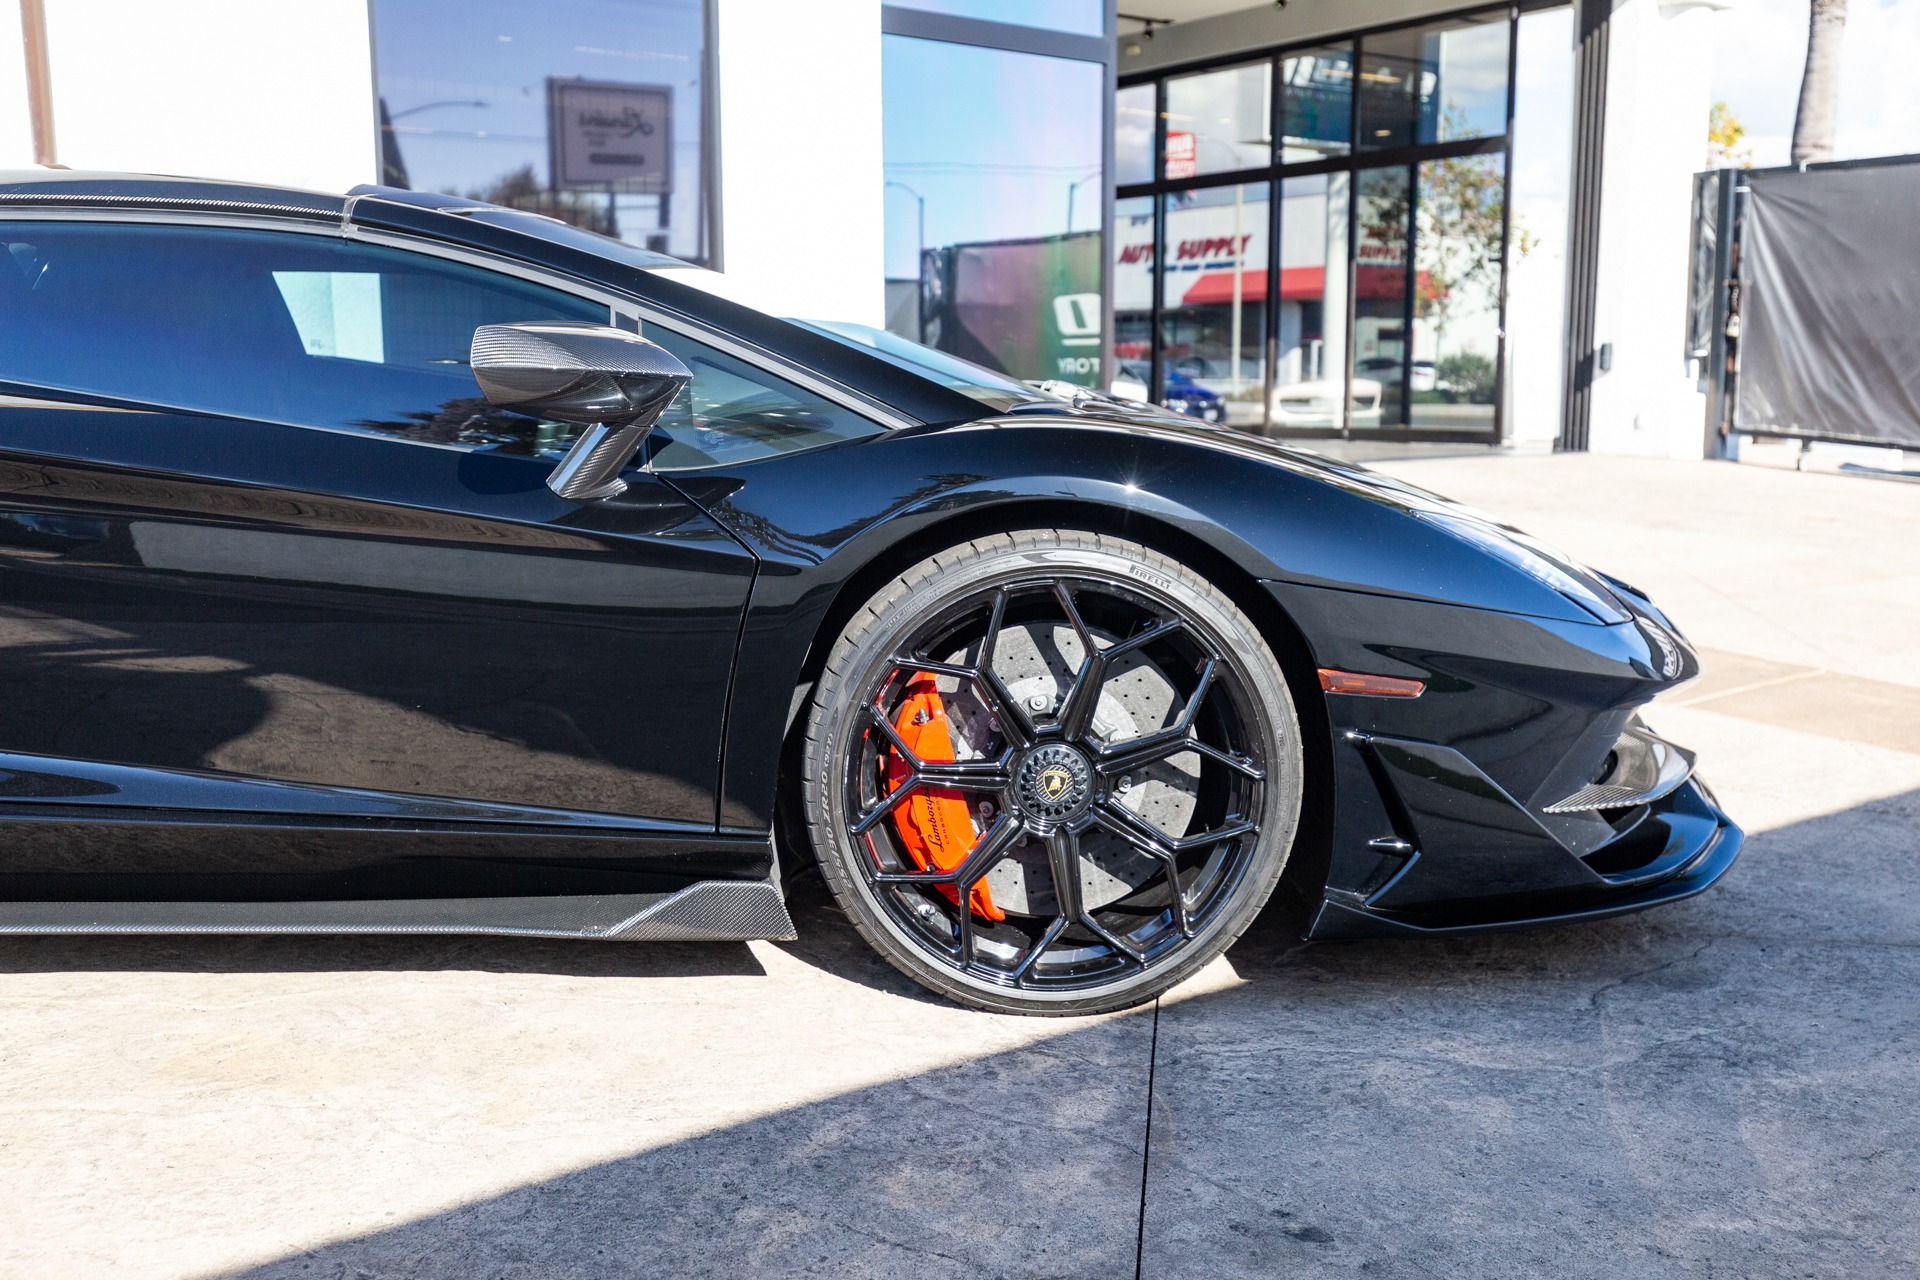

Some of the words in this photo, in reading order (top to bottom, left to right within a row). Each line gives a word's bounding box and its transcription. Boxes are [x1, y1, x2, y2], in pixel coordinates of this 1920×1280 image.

[1118, 242, 1167, 264] AUT
[1177, 233, 1251, 260] SUPPLY
[1129, 564, 1172, 590] PIRELLI
[821, 770, 831, 824] ZR20
[921, 786, 945, 853] Lamborghi
[826, 826, 852, 889] 255/30
